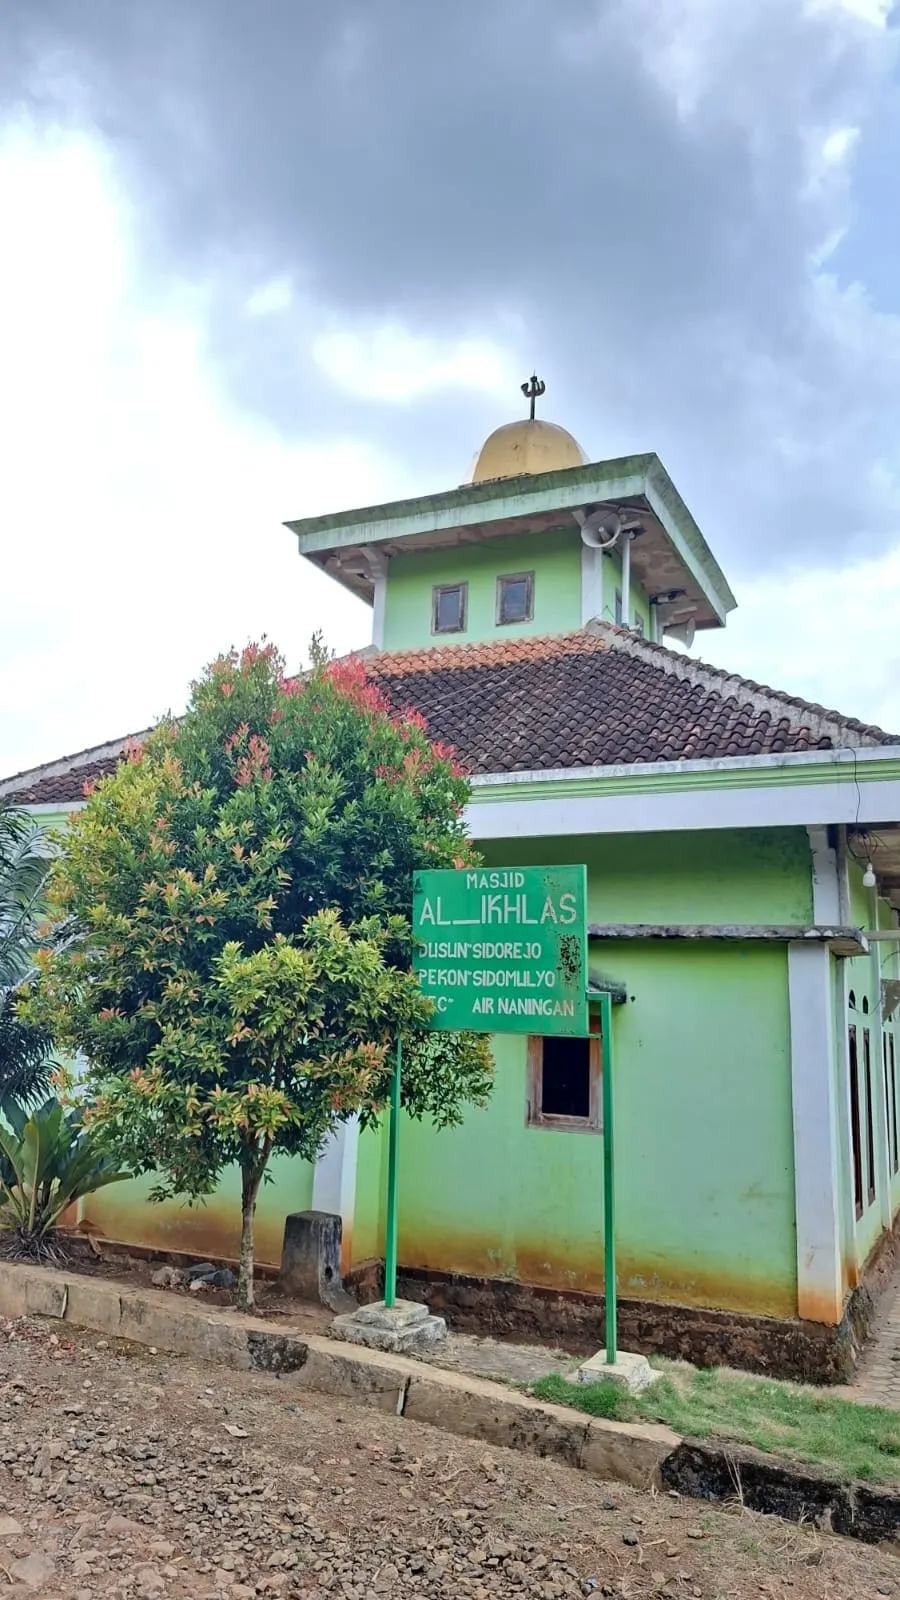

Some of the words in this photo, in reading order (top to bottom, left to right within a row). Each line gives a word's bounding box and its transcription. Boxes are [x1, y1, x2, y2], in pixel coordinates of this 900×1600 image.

[466, 872, 525, 889] MASJID
[472, 997, 494, 1014] AIR
[498, 998, 574, 1016] NANINGAN
